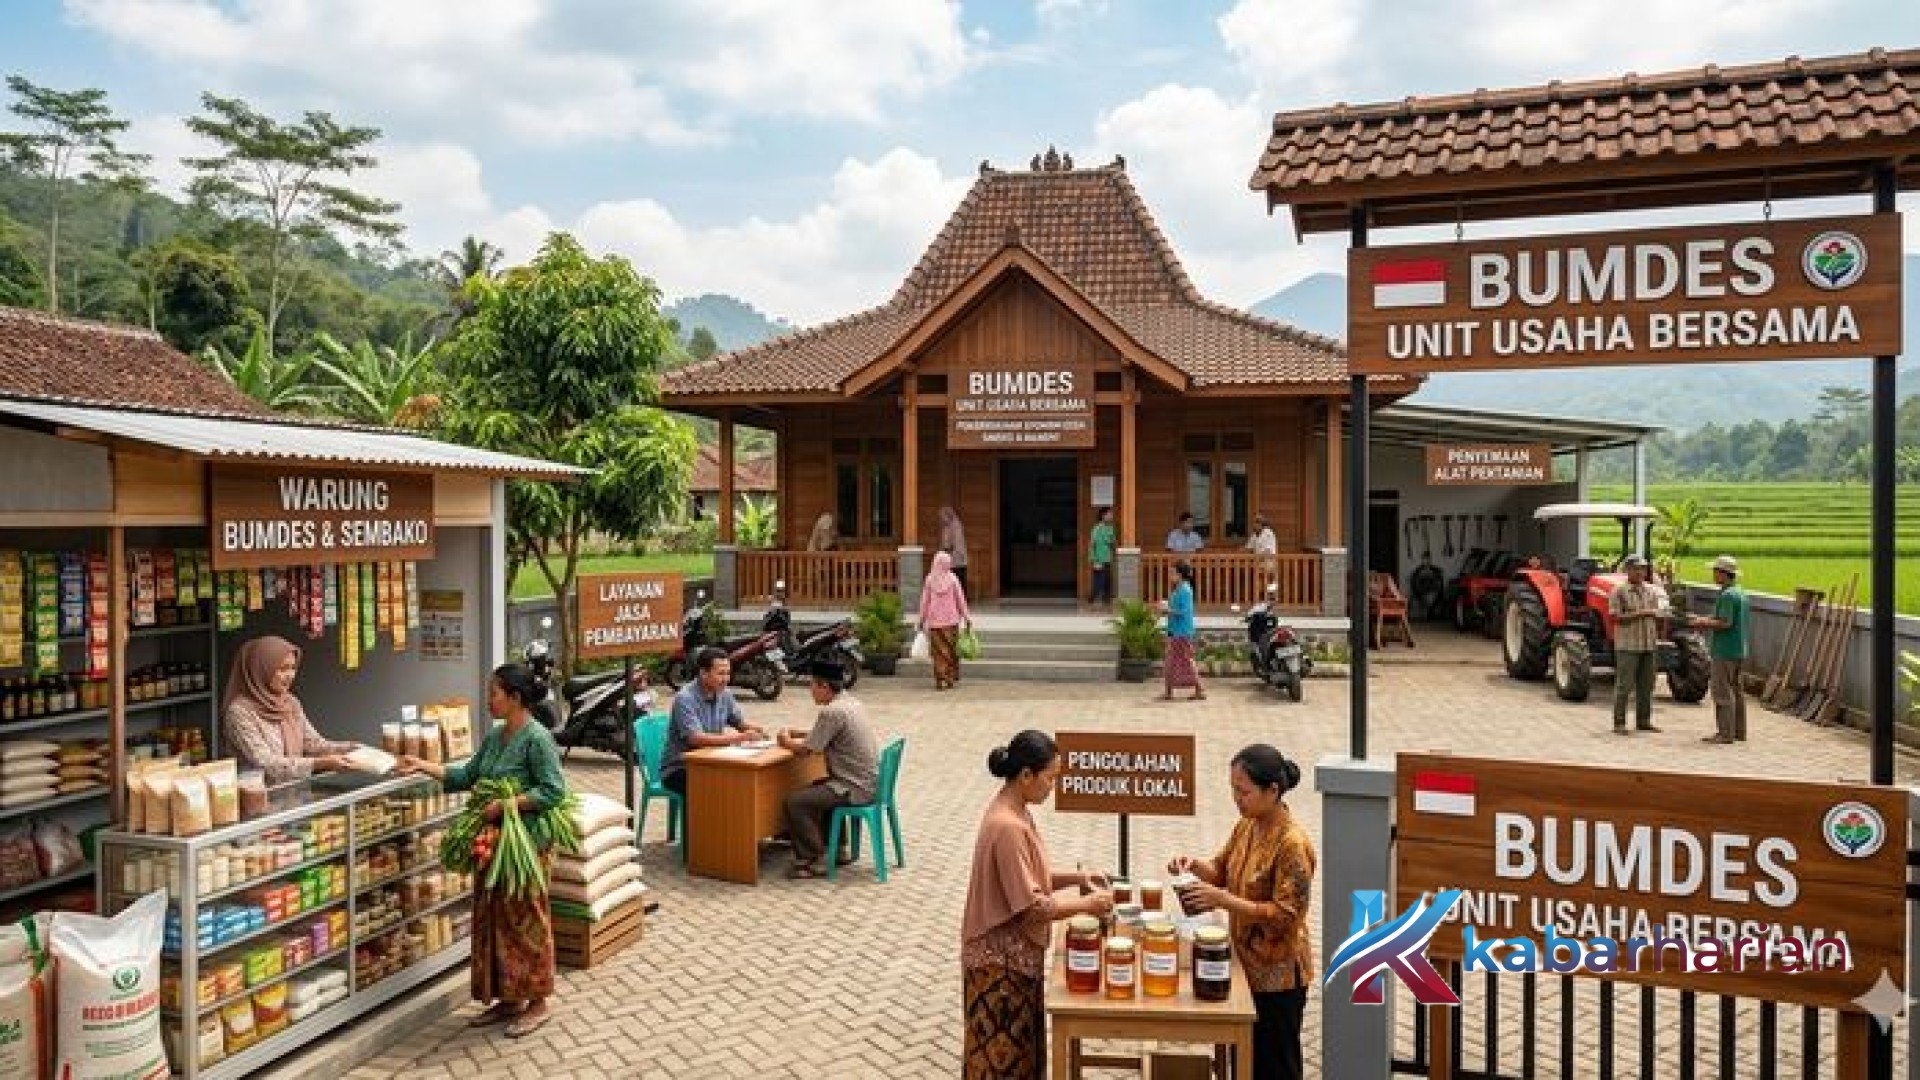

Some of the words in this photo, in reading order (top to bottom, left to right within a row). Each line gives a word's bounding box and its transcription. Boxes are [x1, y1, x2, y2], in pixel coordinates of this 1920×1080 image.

[1470, 237, 1776, 310] BUMDES
[1387, 321, 1480, 360] UNIT
[1493, 314, 1635, 354] USAHA
[1649, 305, 1860, 349] BERSAMA
[968, 371, 1074, 395] BUMDES
[1434, 465, 1467, 480] ALAT
[279, 476, 390, 511] WARUNG
[224, 520, 316, 551] BUMDES
[321, 520, 335, 548] &
[340, 520, 428, 547] SEMBAKO
[600, 580, 664, 602] LAYANAN
[613, 603, 651, 624] JASA
[1068, 751, 1182, 773] PENGOLAHAN
[1062, 776, 1130, 795] PRODUK
[1134, 776, 1188, 797] LOKAL
[1494, 812, 1800, 908] BUMDES
[1531, 899, 1651, 943] USAHA
